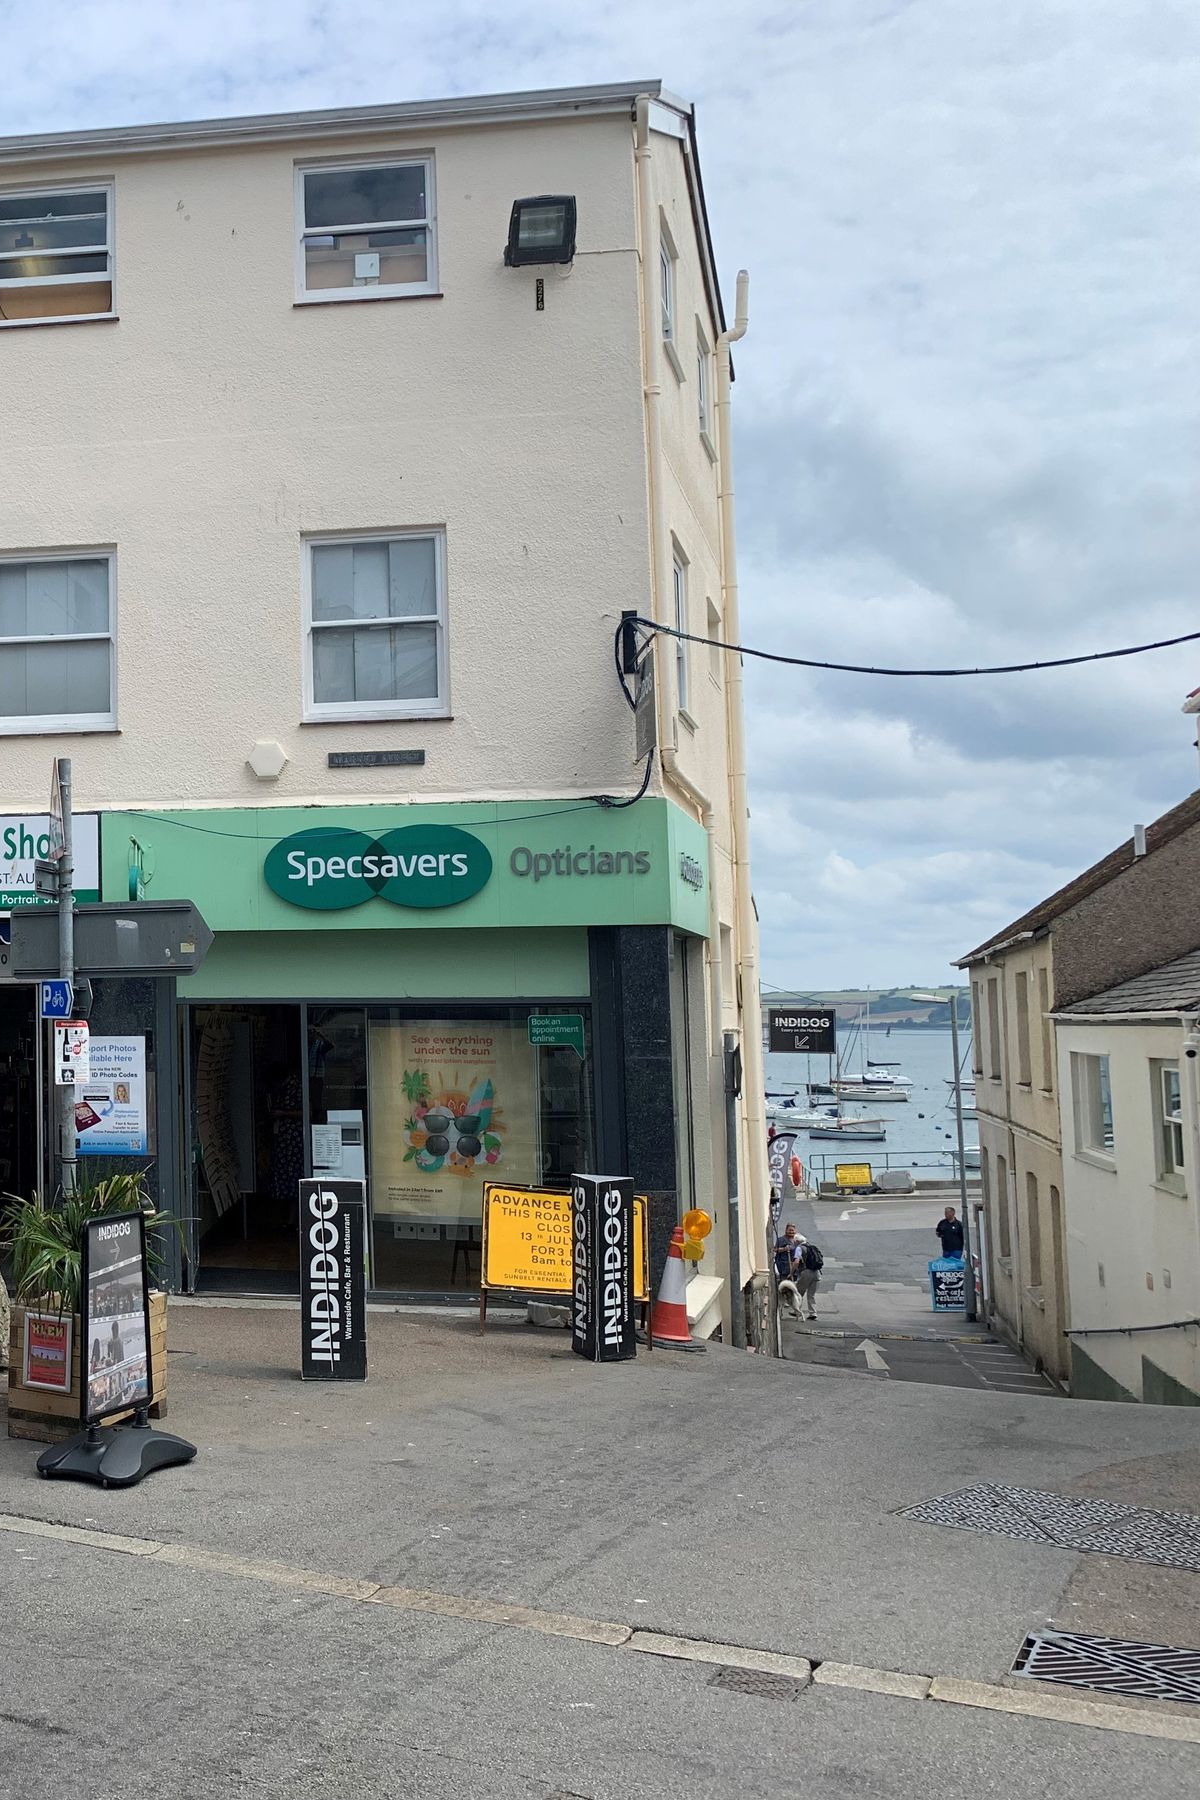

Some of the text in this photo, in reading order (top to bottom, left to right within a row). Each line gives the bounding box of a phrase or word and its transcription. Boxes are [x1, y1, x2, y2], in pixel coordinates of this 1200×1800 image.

[3, 823, 50, 861] Sho
[286, 849, 469, 886] Specsavers
[510, 845, 652, 882] Opticians
[42, 984, 52, 1012] P
[531, 1018, 550, 1026] Book
[531, 1026, 579, 1034] appointment
[775, 1017, 830, 1027] INDIDOG
[411, 1034, 493, 1046] See everything
[109, 1044, 137, 1053] Photos
[414, 1046, 490, 1056] under the sun
[492, 1194, 561, 1211] ADVANCE
[502, 1207, 570, 1223] THIS ROAD
[97, 1221, 131, 1241] INDIDOG
[343, 1213, 351, 1255] Restaurant
[520, 1232, 532, 1241] 13
[537, 1223, 570, 1234] CLOS
[531, 1256, 572, 1266] 8am to
[603, 1189, 623, 1346] INDIDOG
[308, 1191, 341, 1361] INDIDOG
[504, 1273, 567, 1283] SUNBELT RENTALS
[529, 1269, 566, 1277] ESSENTIAL
[344, 1279, 352, 1300] Cafe,
[344, 1301, 352, 1340] Waterside
